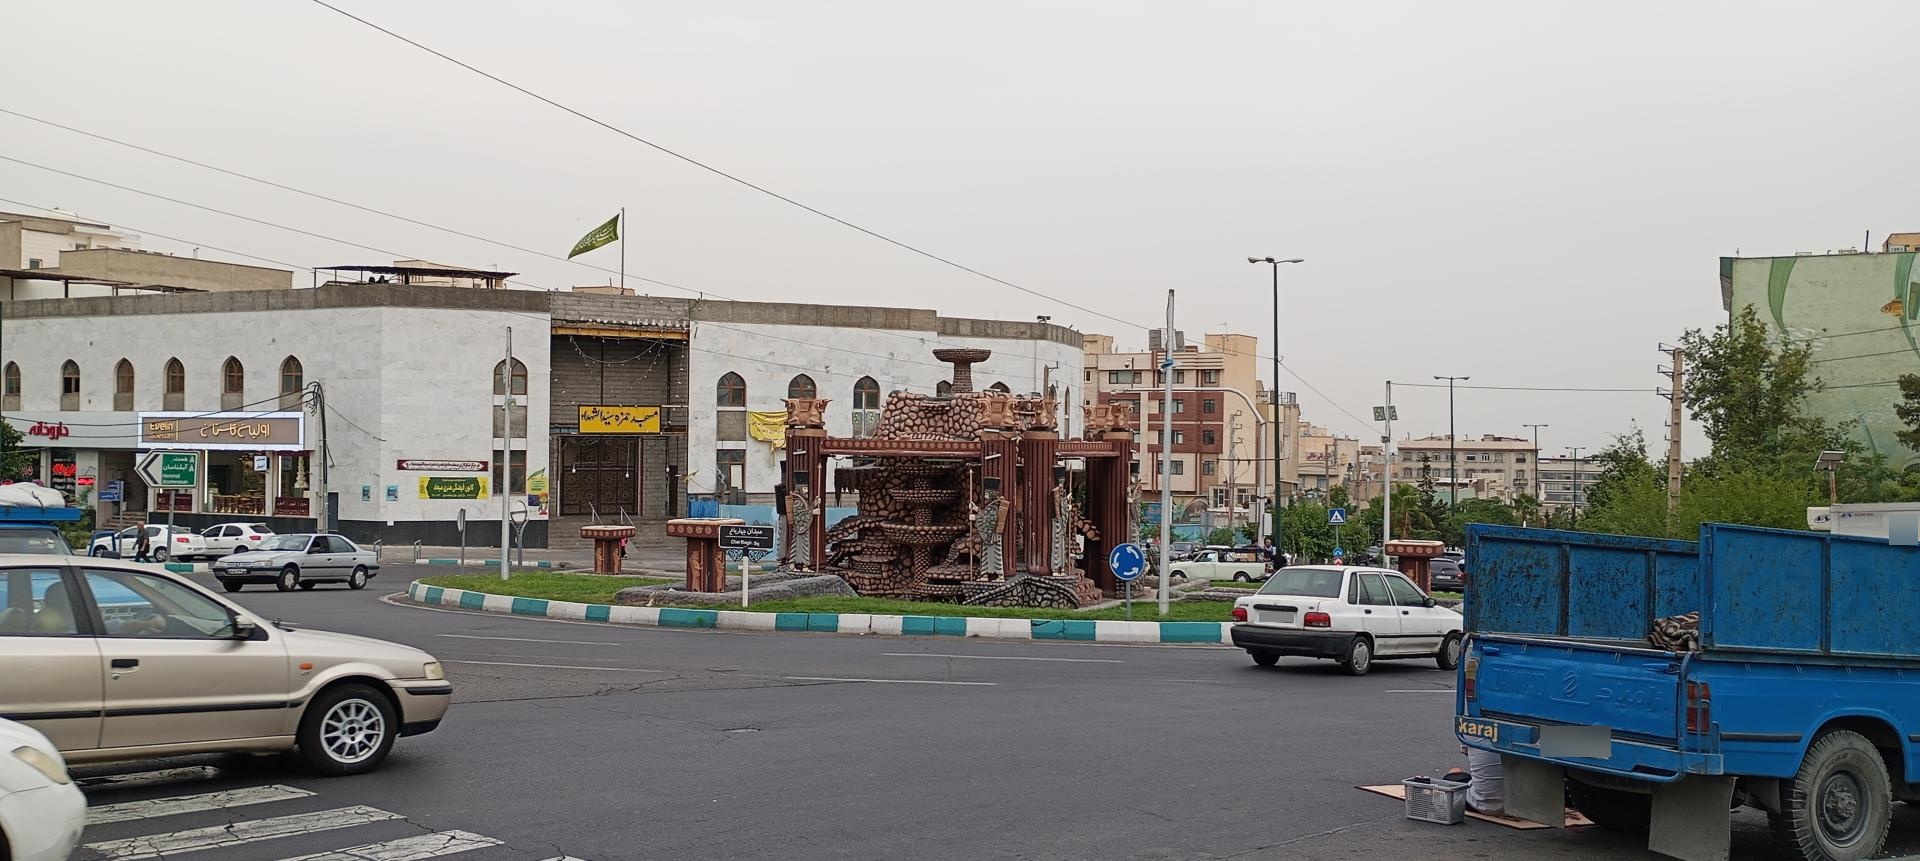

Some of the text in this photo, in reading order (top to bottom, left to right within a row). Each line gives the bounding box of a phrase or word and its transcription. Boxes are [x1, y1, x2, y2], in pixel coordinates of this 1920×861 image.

[614, 411, 631, 426] حمزه
[631, 411, 658, 428] مسجد
[29, 421, 69, 440] داروخانه
[149, 422, 173, 431] Evelin
[162, 463, 188, 471] آبشناسان
[747, 527, 763, 536] میدان
[1458, 717, 1498, 743] karaj
